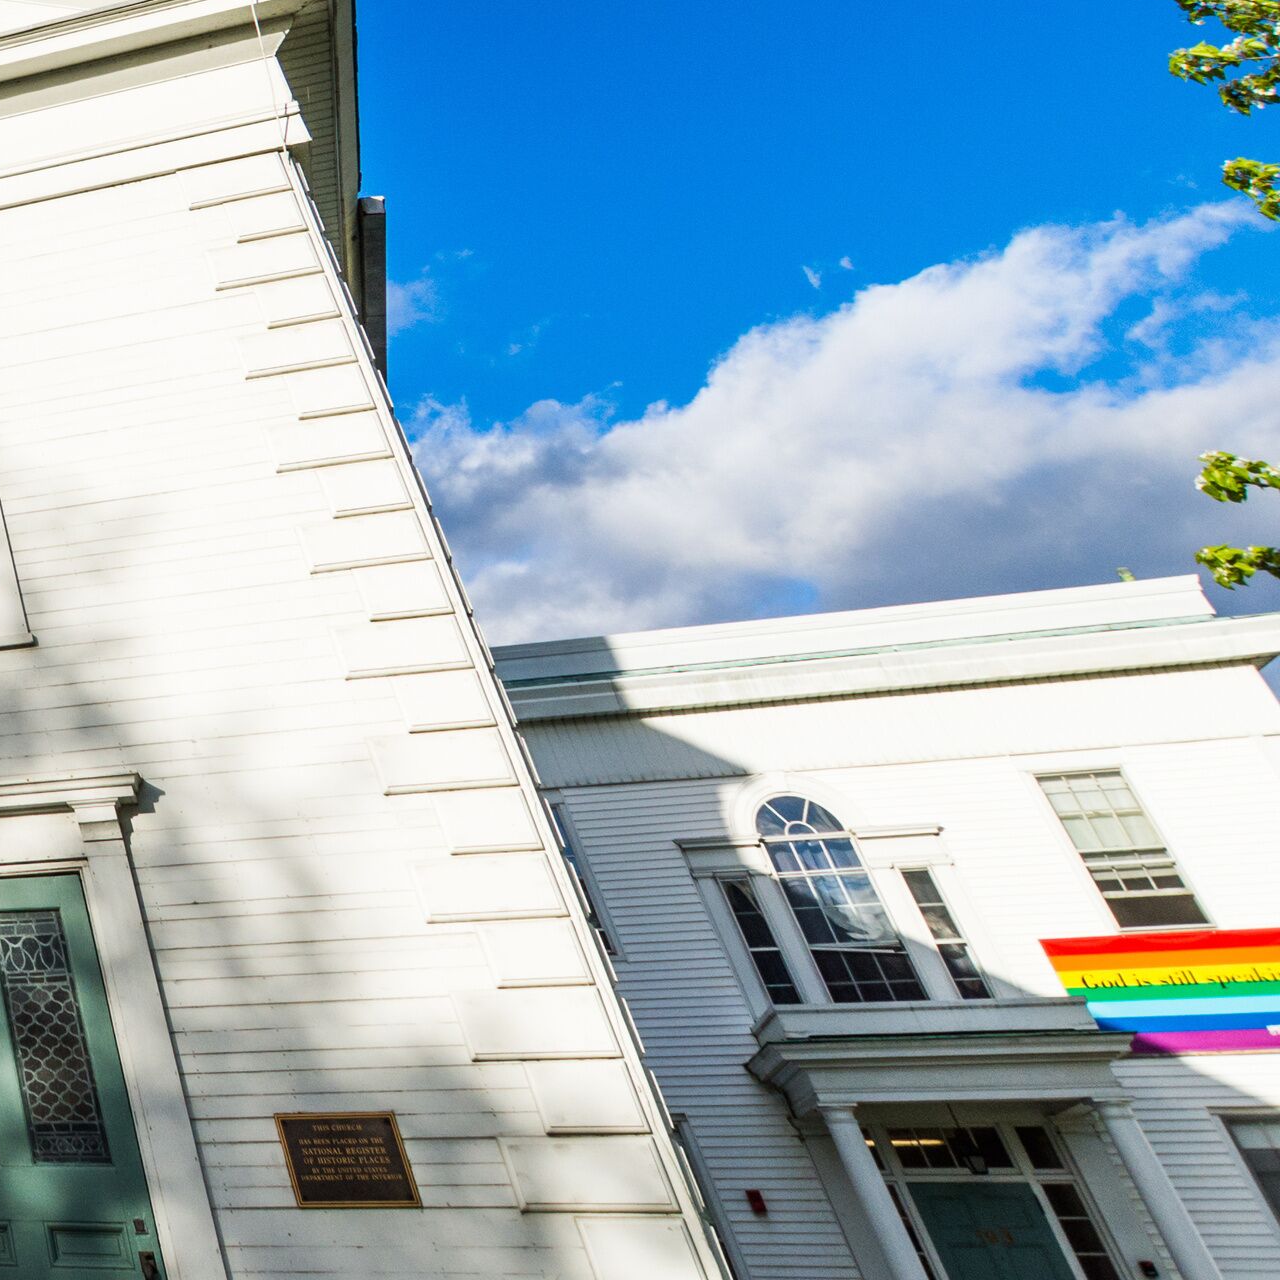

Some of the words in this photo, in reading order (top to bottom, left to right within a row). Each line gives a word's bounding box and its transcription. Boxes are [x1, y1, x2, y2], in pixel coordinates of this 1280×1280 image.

[1081, 973, 1127, 989] God
[1131, 973, 1152, 987] is
[1160, 970, 1199, 985] still
[1207, 968, 1280, 989] speaki
[331, 1123, 363, 1132] CHURCH
[302, 1147, 342, 1156] NATIONAL
[346, 1147, 386, 1155] REGISTER
[303, 1157, 315, 1165] OF
[317, 1157, 357, 1165] HISTORIC
[358, 1156, 391, 1165] PLACES
